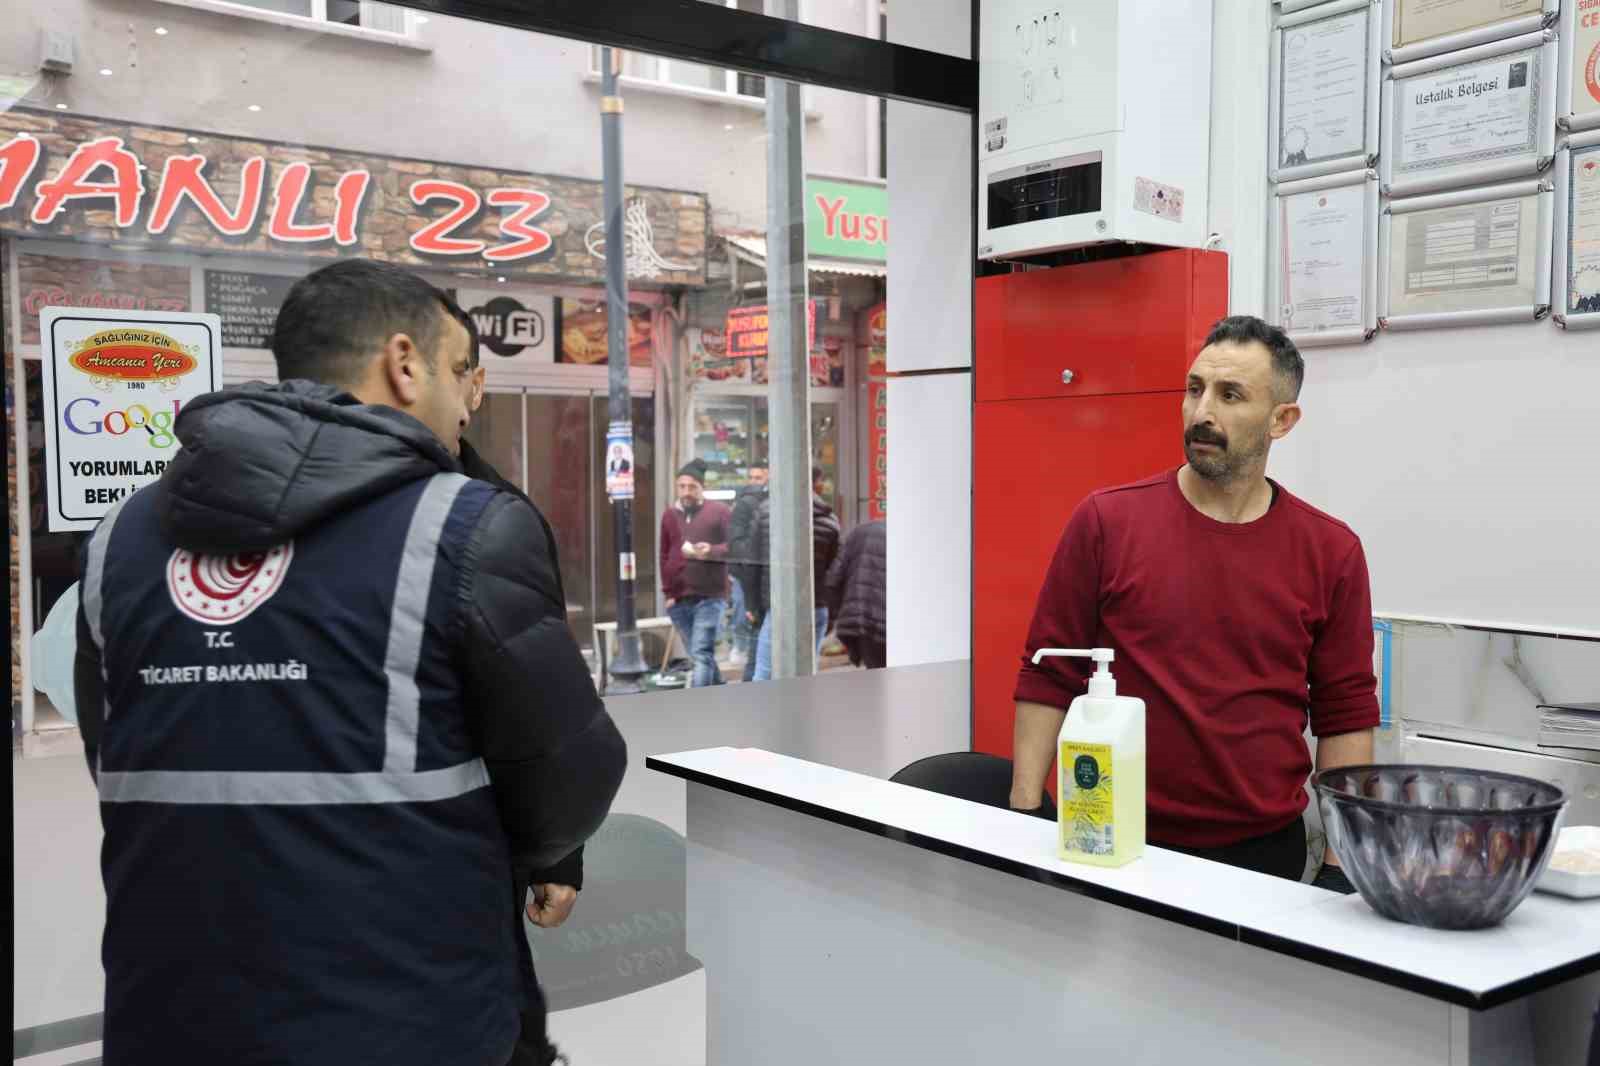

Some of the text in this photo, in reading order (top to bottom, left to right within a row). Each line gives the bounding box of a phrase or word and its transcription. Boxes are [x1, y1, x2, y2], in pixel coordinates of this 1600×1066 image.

[1581, 12, 1600, 28] CE
[1457, 77, 1499, 97] Belgesi
[408, 178, 552, 262] 23
[127, 381, 146, 390] 1980
[63, 397, 182, 449] Goog
[69, 460, 171, 477] YORUMLAR
[138, 659, 308, 686] TİCARET BAKANLIĞI
